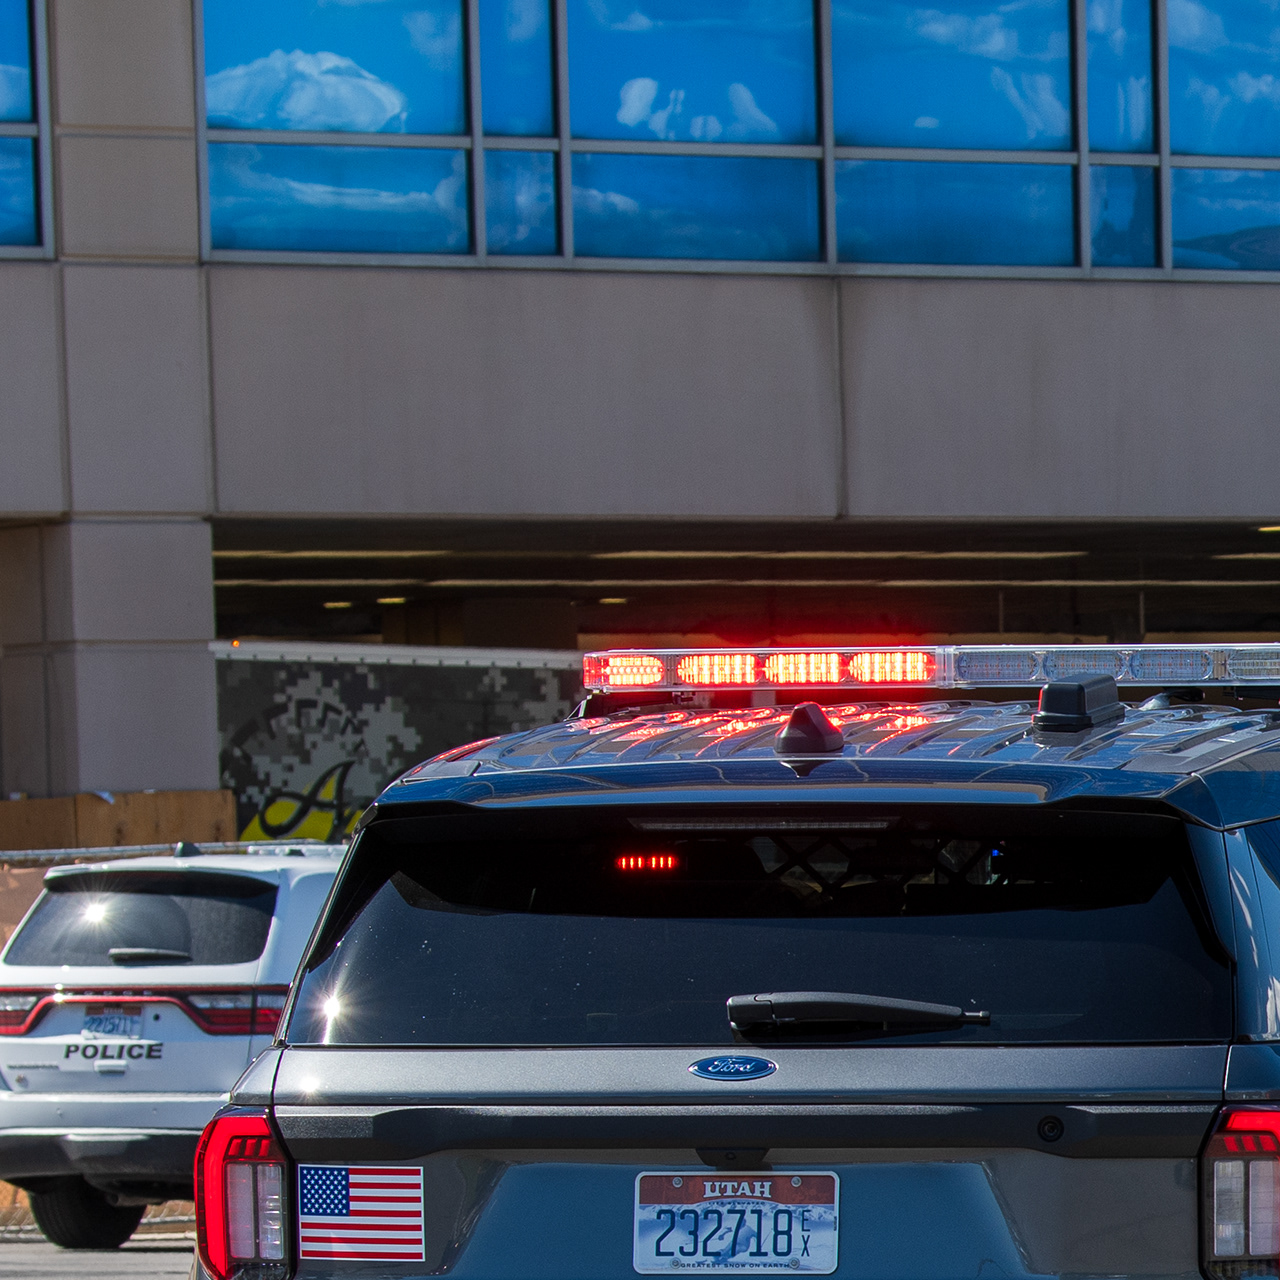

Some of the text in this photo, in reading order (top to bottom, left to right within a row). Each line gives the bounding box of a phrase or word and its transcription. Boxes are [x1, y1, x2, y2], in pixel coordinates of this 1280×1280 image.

[63, 1043, 164, 1060] POLICE
[708, 1058, 756, 1073] Ford
[703, 1181, 772, 1198] UTAH
[655, 1209, 793, 1257] 232718
